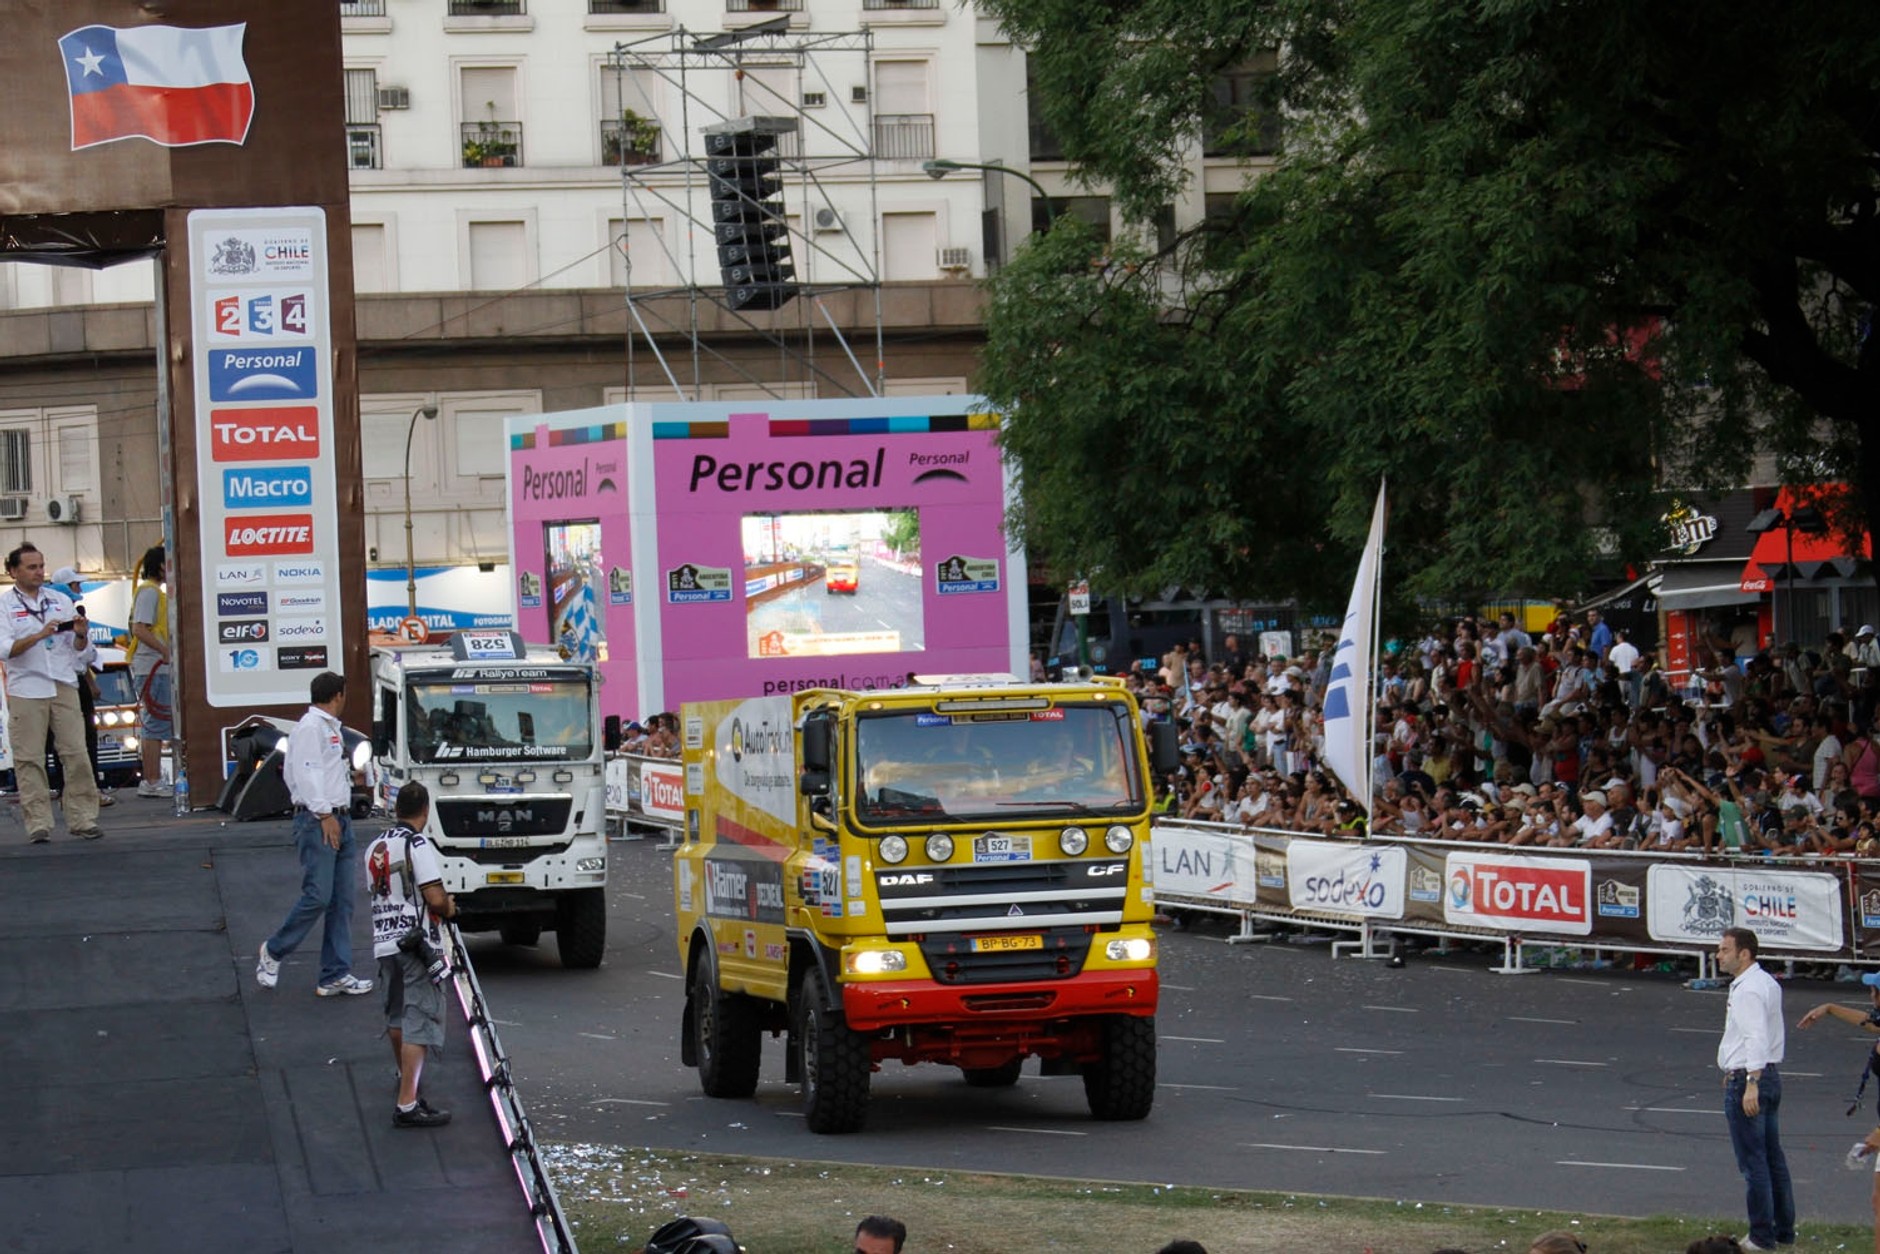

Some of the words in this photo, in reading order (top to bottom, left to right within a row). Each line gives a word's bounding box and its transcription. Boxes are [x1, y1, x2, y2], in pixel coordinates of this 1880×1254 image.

[264, 245, 309, 259] CHILE
[221, 306, 240, 330] 2
[254, 306, 272, 330] 3
[286, 304, 305, 328] 4
[224, 352, 302, 369] Personal
[214, 424, 316, 444] TOTAL
[909, 451, 970, 466] Personal
[690, 448, 886, 492] Personal
[524, 456, 588, 500] Personal
[230, 478, 308, 498] Macro
[229, 526, 309, 545] LOCTITE
[220, 571, 246, 580] LAN
[278, 568, 320, 576] NOKIA
[942, 583, 978, 592] Personal
[221, 597, 264, 606] NOVOTEL
[674, 592, 710, 600] Personal
[423, 614, 456, 627] GITAL
[89, 628, 112, 641] GITAL
[223, 626, 250, 638] elf
[280, 626, 324, 636] sodexo
[764, 674, 905, 696] personal.com.a
[1032, 710, 1064, 719] TOTAL
[466, 746, 522, 758] Hamburger
[524, 744, 566, 757] Software
[478, 810, 532, 822] MAN
[991, 840, 1008, 851] 527
[977, 852, 1010, 862] Personal
[1162, 847, 1211, 877] LAN
[1087, 864, 1124, 876] CF
[822, 870, 839, 896] 527
[880, 874, 934, 886] DAF
[1306, 870, 1385, 908] sodexo
[1476, 871, 1582, 915] TOTAL
[1744, 895, 1796, 918] CHILE
[981, 936, 1036, 950] BP-BG-73
